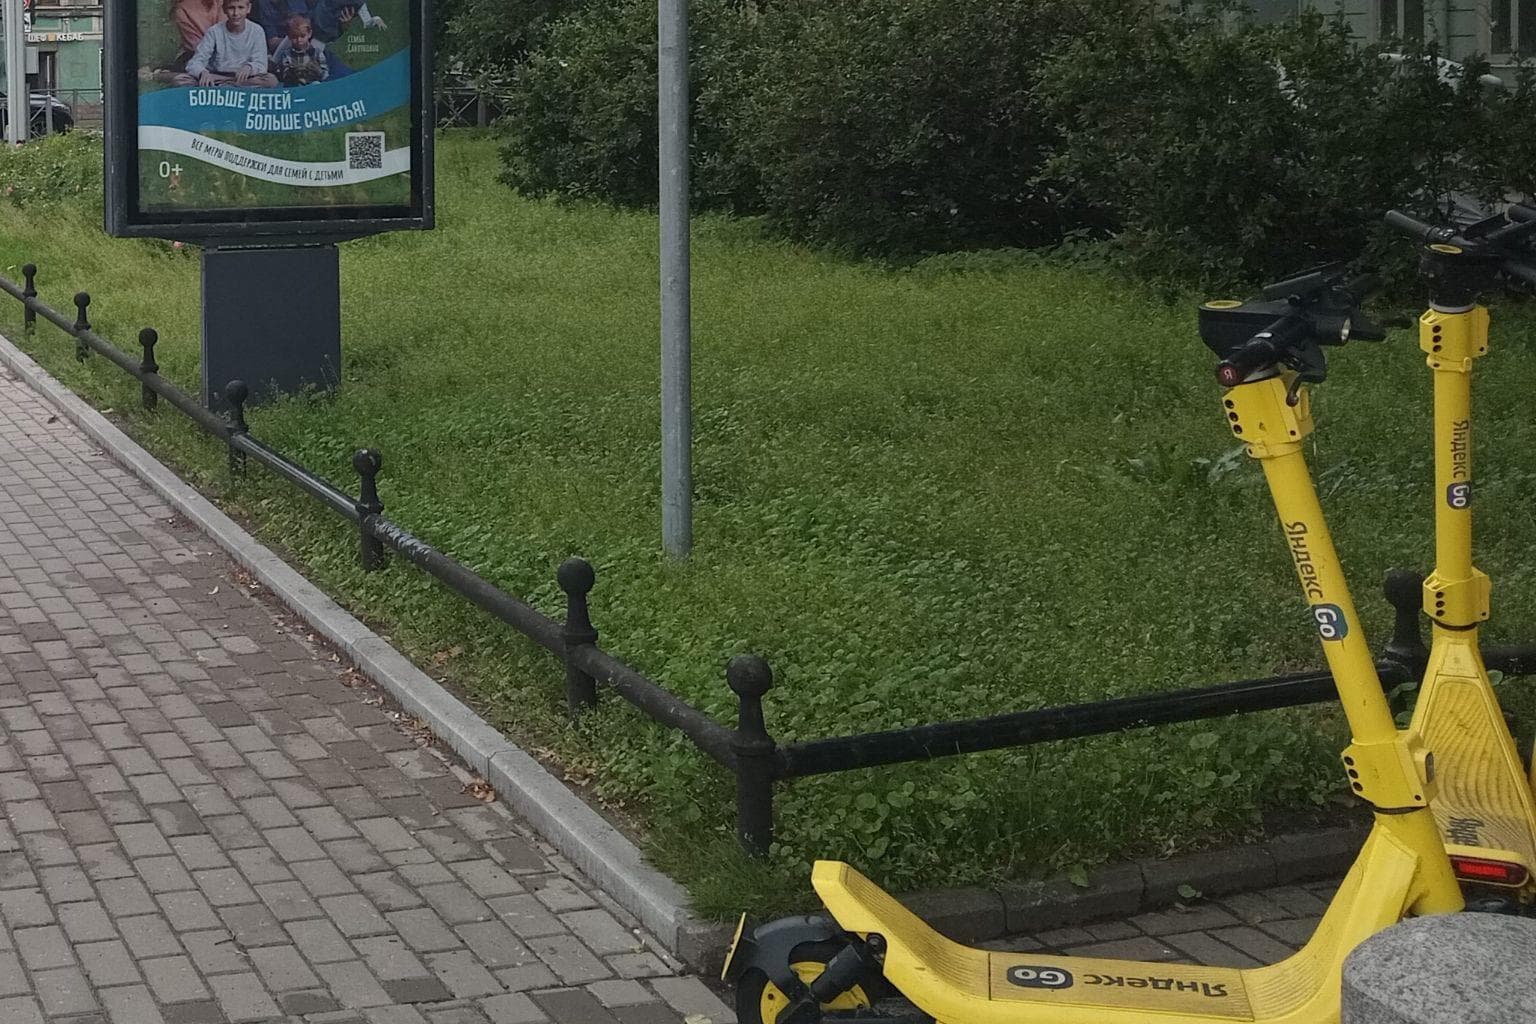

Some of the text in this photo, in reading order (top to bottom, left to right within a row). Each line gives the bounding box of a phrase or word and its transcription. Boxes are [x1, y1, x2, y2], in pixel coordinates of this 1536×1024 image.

[56, 32, 84, 41] КЕБАБ
[189, 89, 246, 109] БОЛЬШЕ
[247, 90, 292, 112] ДЕТЕЙ
[245, 99, 368, 131] БОЛЬШЕ СЧАСТЬЯ!
[158, 161, 184, 178] 0+
[191, 138, 203, 152] ВСЕ
[204, 142, 223, 159] МЕРЫ
[224, 150, 267, 172] ПОДДЕРЖКИ
[266, 163, 283, 177] ДЛЯ
[284, 164, 308, 180] СЕМЕЙ
[313, 168, 344, 182] ДЕТЬМИ
[1450, 420, 1471, 507] Яндекс Go
[1285, 521, 1338, 638] Яндекс Go
[1013, 968, 1229, 998] Яндекс Go
